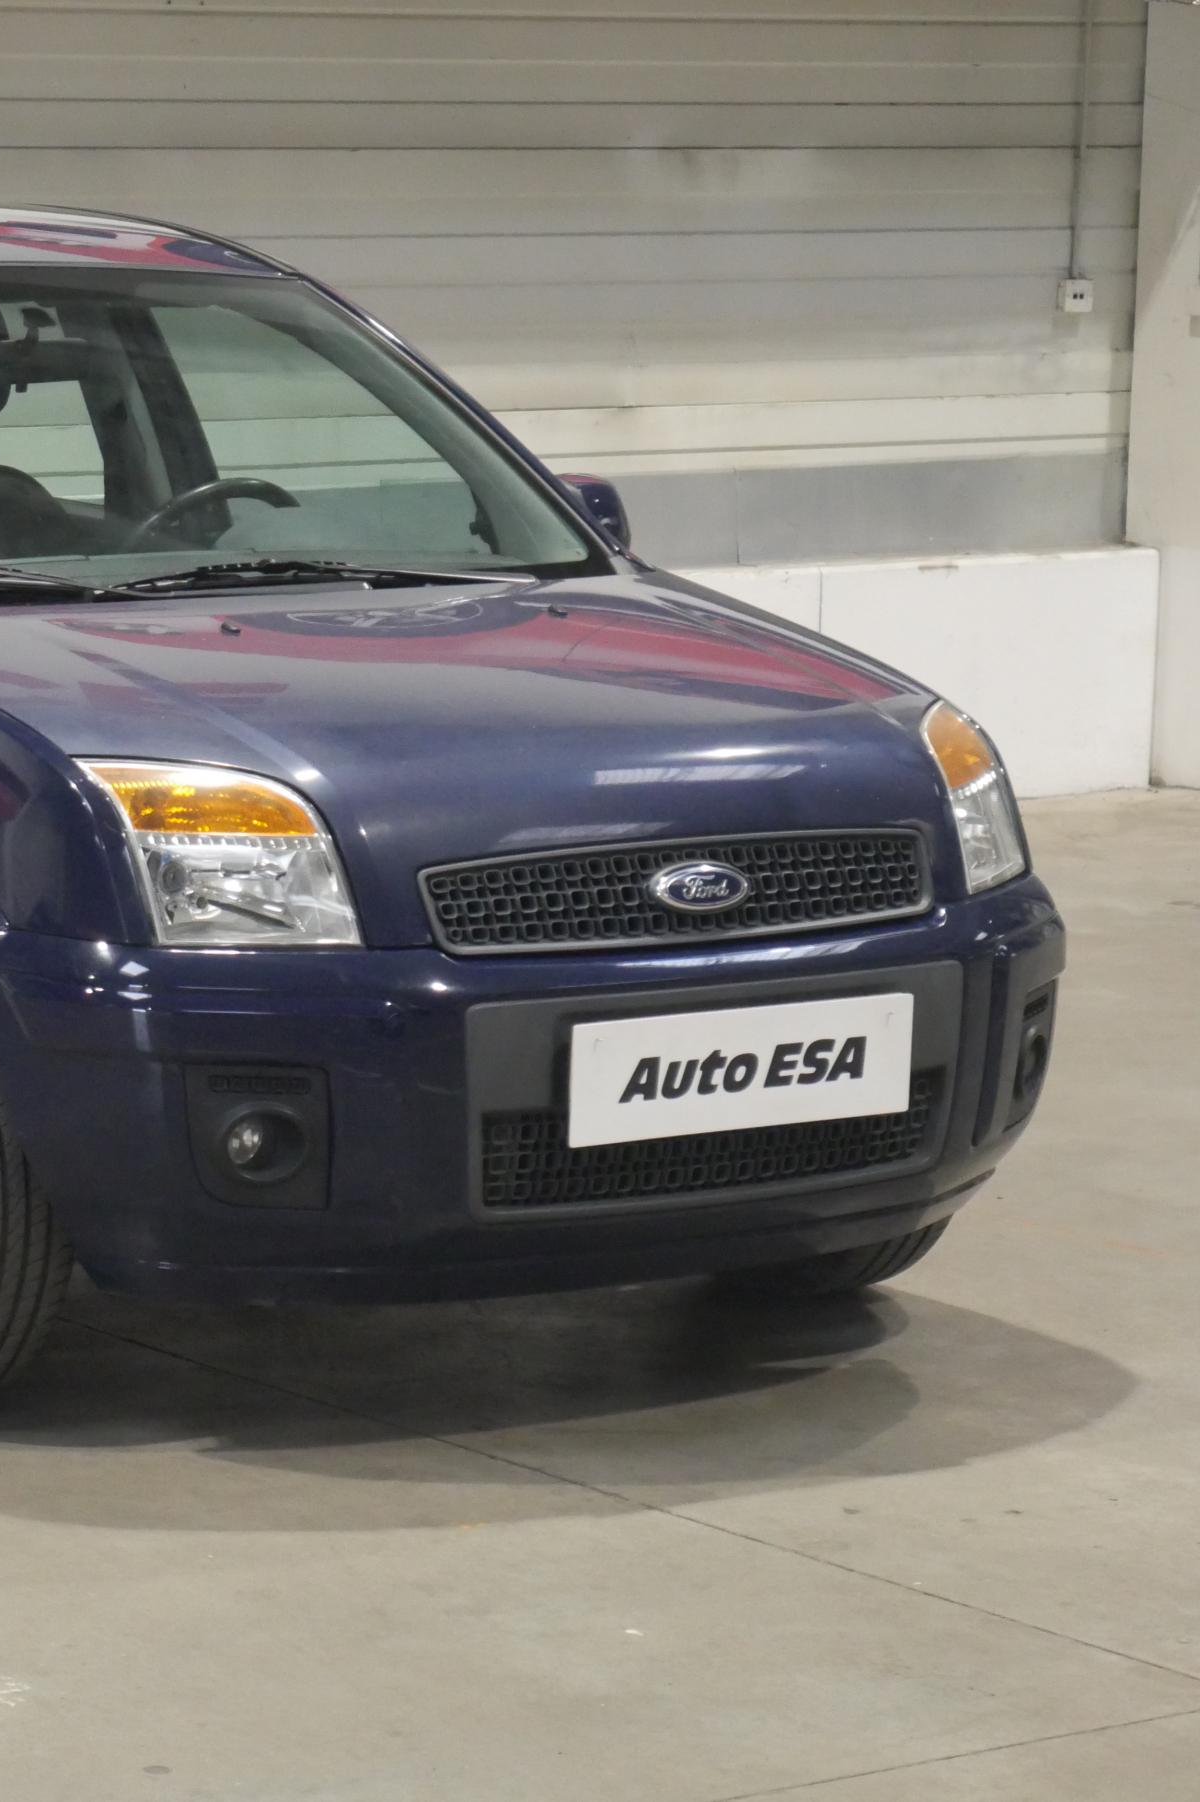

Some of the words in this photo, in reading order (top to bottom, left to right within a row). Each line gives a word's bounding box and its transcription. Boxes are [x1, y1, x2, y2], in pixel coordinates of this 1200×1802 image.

[682, 874, 730, 900] Ford
[618, 1050, 759, 1104] Auto
[763, 1035, 867, 1088] ESA
